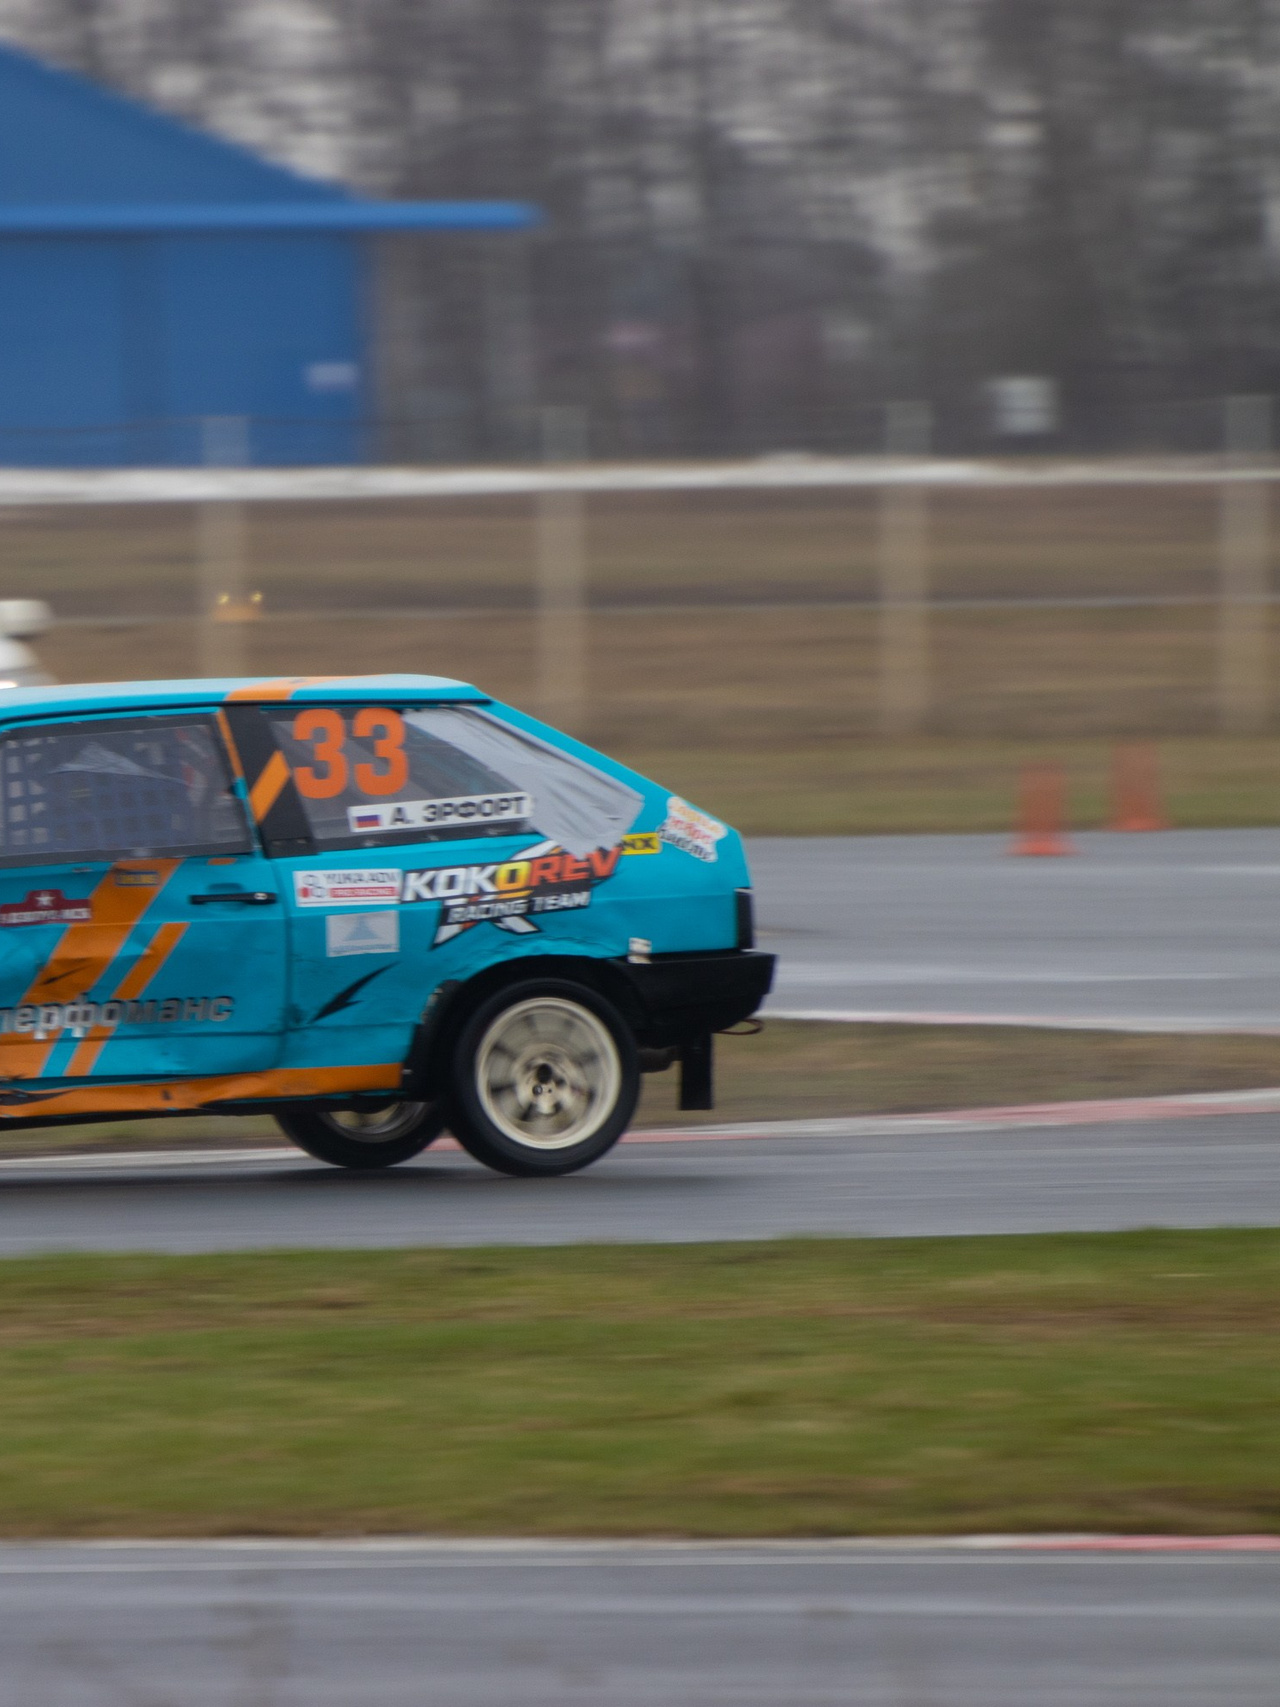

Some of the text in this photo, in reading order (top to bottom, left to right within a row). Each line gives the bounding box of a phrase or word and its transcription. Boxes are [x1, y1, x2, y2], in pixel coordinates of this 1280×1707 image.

[293, 708, 409, 799] 33
[390, 796, 525, 826] А. ЭРФОРТ
[403, 846, 621, 902] KOKOREV
[449, 890, 591, 924] RACING TEAM
